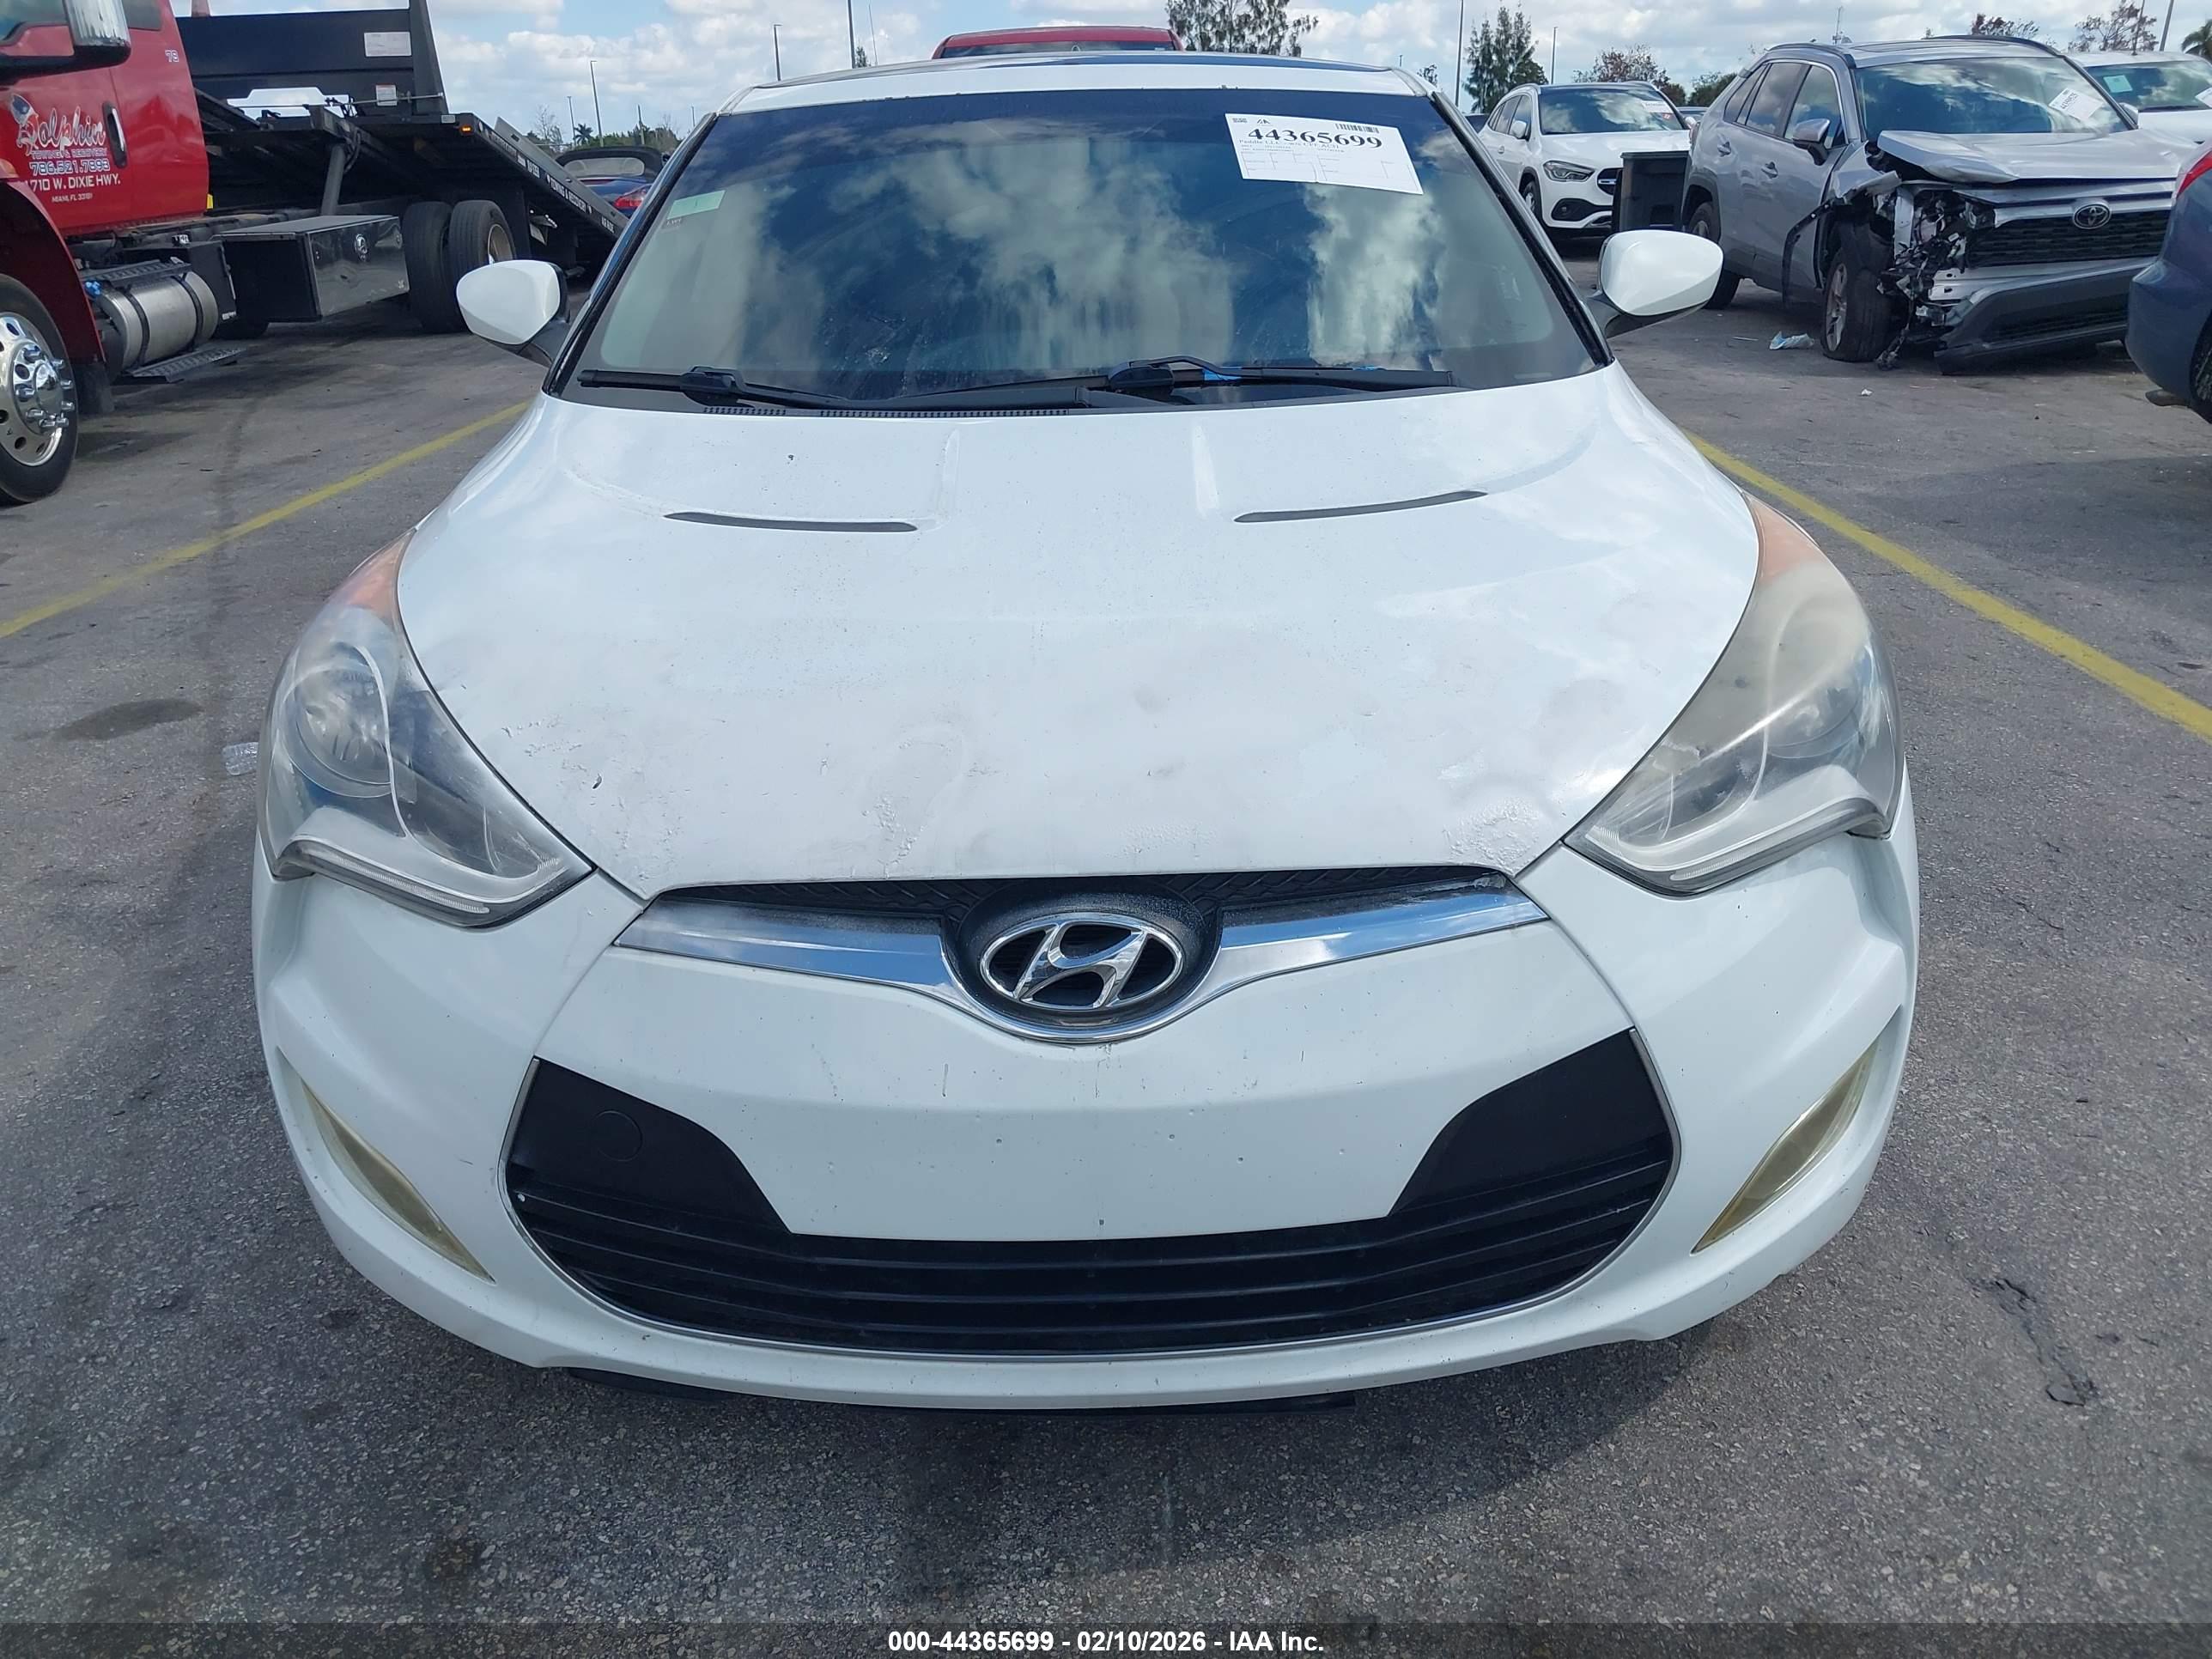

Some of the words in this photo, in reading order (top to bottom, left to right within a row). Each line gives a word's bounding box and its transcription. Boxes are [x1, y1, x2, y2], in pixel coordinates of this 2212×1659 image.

[1248, 128, 1382, 149] 44365699
[52, 177, 66, 190] W.
[69, 175, 94, 189] DIXIE
[95, 173, 121, 185] HWY.
